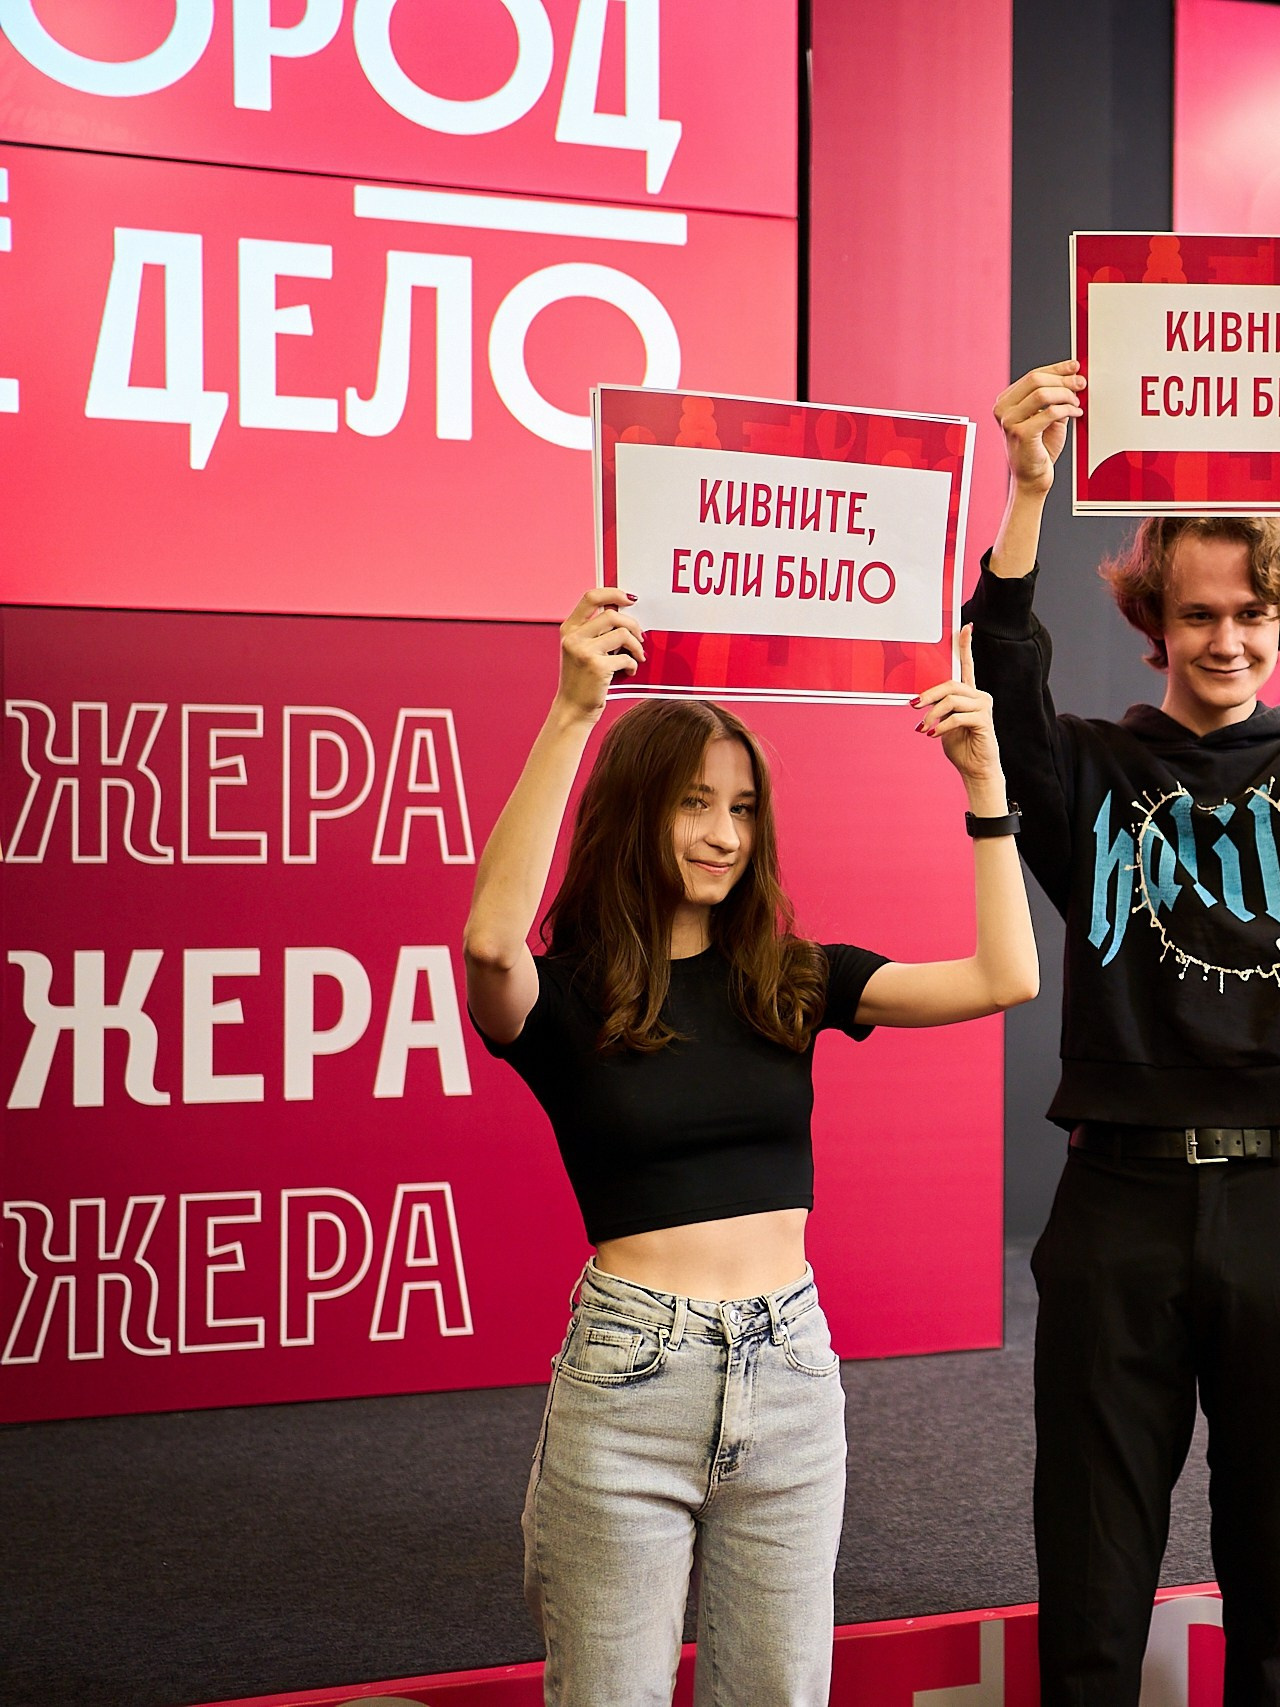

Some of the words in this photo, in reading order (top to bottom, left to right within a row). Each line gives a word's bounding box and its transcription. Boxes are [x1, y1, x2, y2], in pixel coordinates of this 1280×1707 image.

[84, 226, 682, 471] ДЕЛО
[1141, 375, 1238, 418] ЕСЛИ
[671, 548, 764, 597] ЕСЛИ
[775, 555, 896, 604] БЫЛО
[699, 478, 876, 545] КИВНИТЕ,
[4, 699, 476, 866] ЖЕРА
[6, 946, 472, 1111] ЖЕРА
[1, 1182, 474, 1365] ЖЕРА
